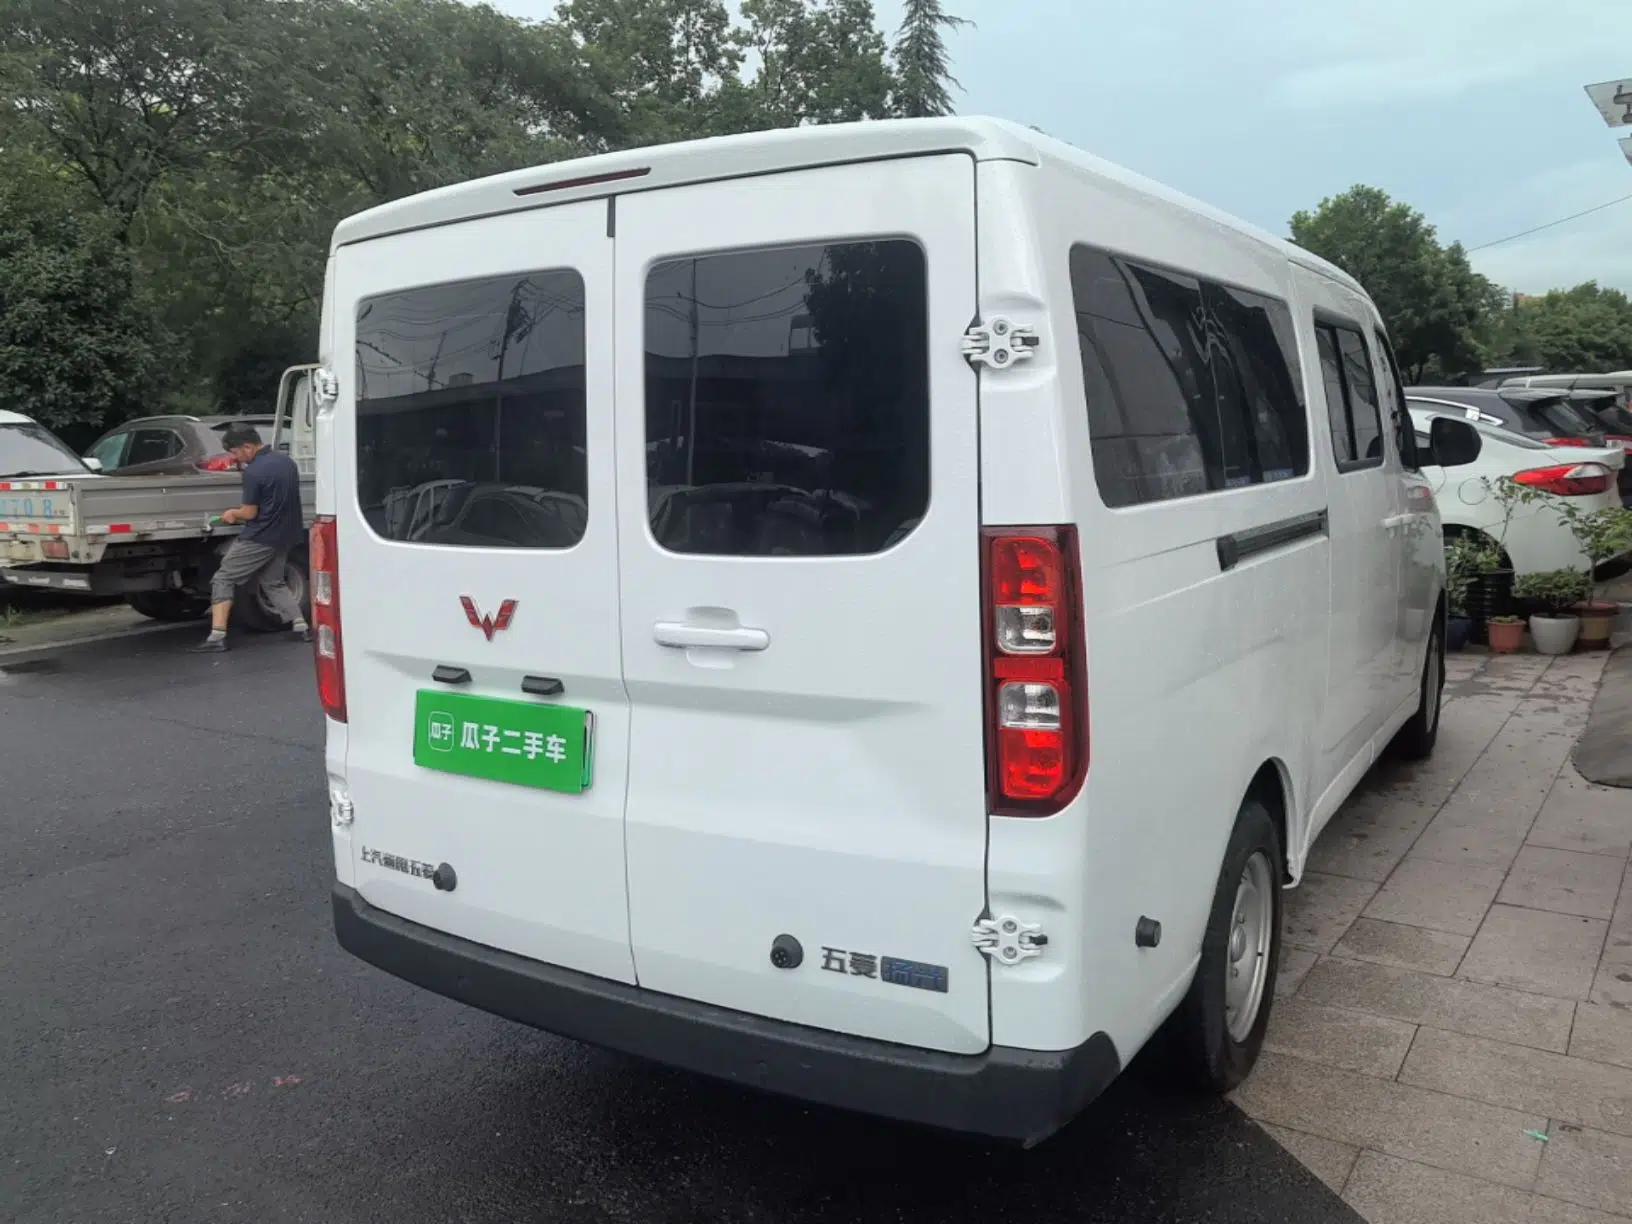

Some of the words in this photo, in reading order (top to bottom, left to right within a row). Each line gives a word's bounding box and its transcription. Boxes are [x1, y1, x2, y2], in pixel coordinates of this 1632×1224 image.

[460, 721, 567, 763] 瓜子二手车
